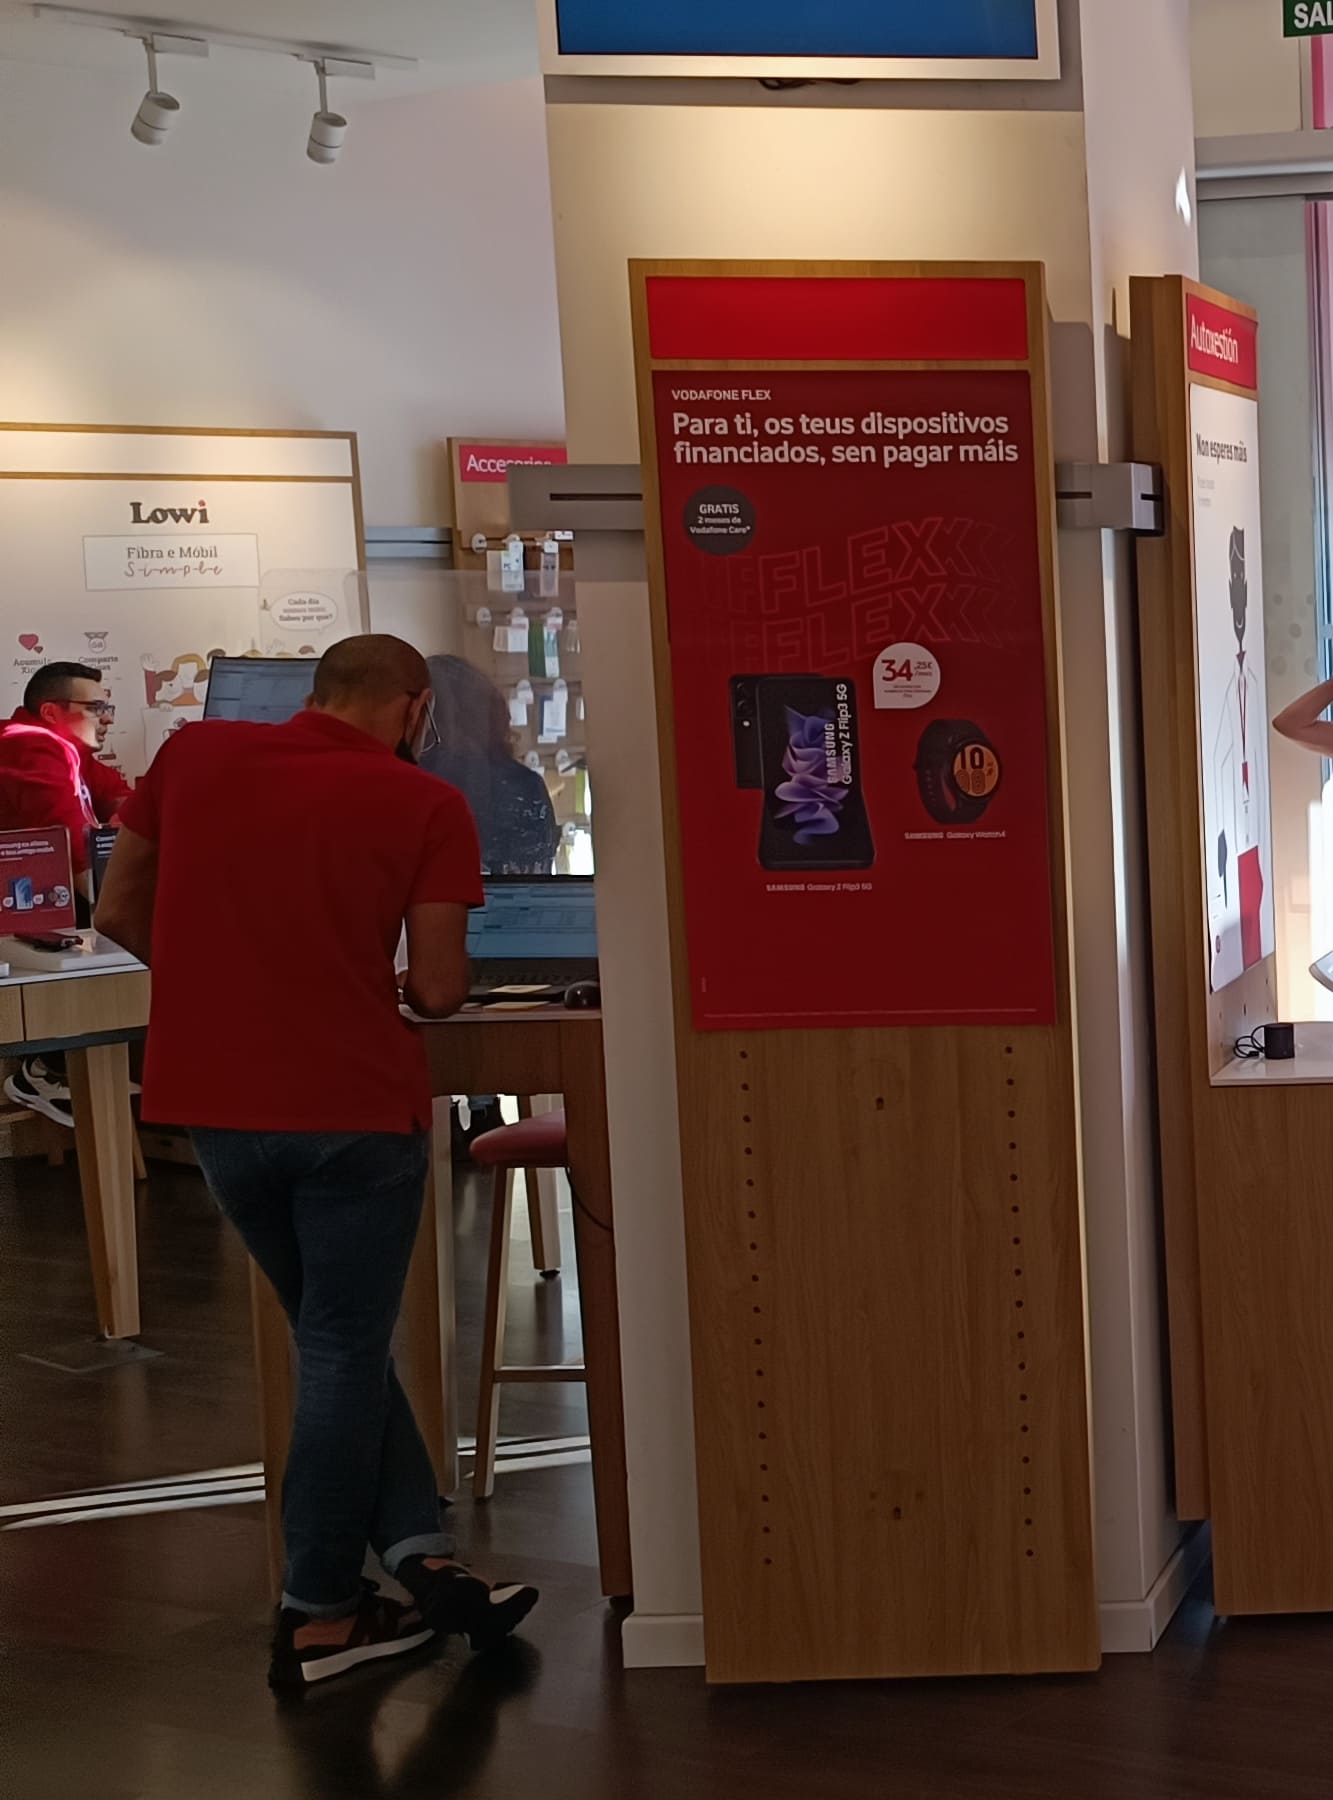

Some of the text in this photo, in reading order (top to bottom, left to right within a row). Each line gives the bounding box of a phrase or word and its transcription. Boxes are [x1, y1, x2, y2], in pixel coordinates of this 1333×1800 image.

[1191, 314, 1239, 364] Autoxestión
[672, 389, 771, 400] VODAFONE FLEX
[673, 411, 1008, 439] Para ti, os teus dispositivos
[673, 439, 1018, 467] financiados, sen pagar máis
[129, 499, 210, 524] Lowi
[699, 504, 739, 514] GRATIS
[127, 546, 218, 559] Fibra e Móbil
[881, 659, 913, 682] 34
[836, 683, 853, 785] Galaxy Z Flip3 5G
[825, 722, 838, 784] SAMSUNG
